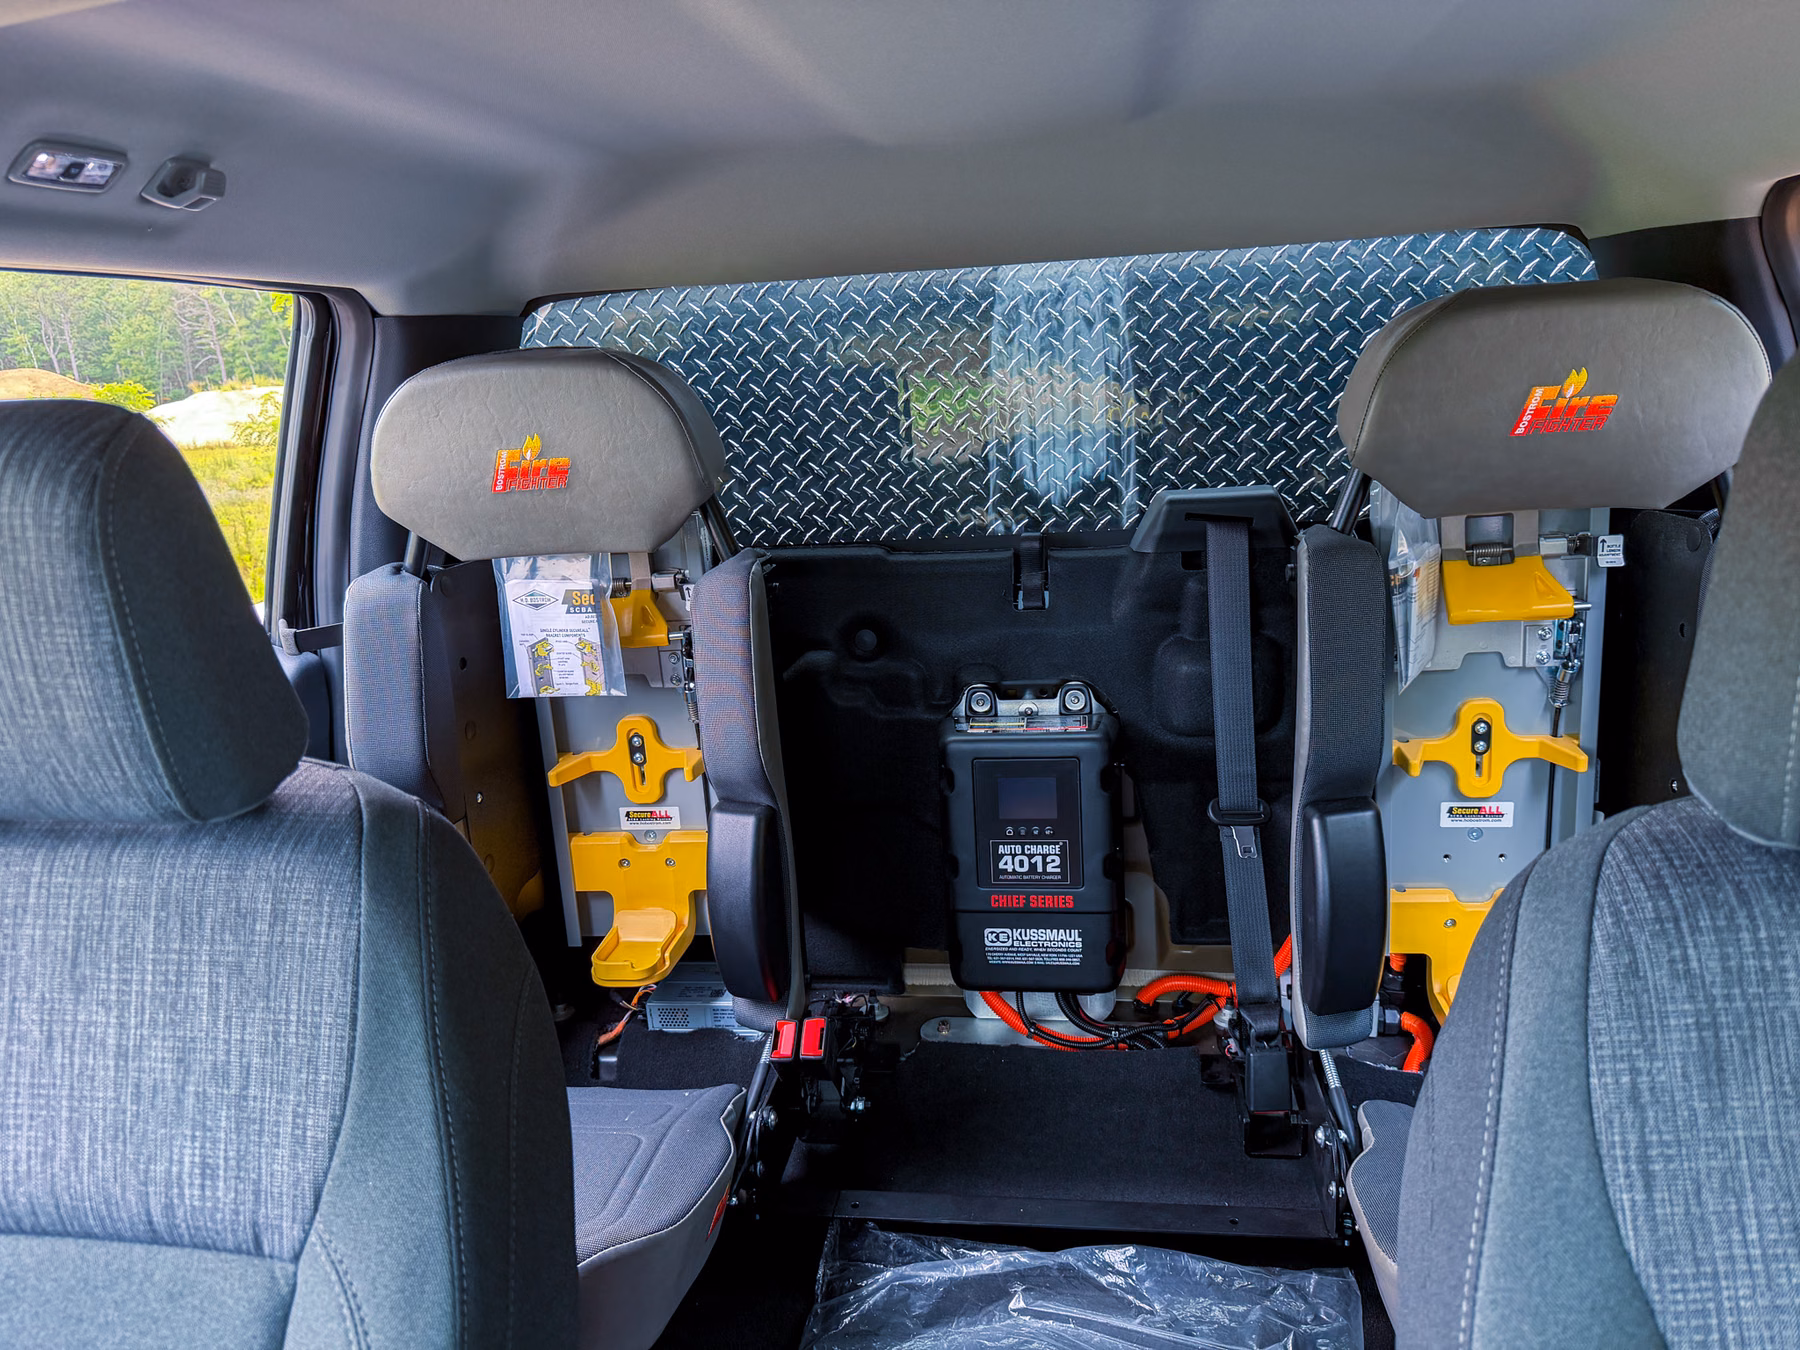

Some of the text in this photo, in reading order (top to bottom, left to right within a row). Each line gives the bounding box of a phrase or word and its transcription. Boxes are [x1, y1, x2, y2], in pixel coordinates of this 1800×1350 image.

[1514, 387, 1545, 435] BOSTROM
[1529, 416, 1608, 434] FIGHTER
[495, 451, 509, 491] BOSTROM
[506, 477, 569, 492] FIGHTER
[998, 844, 1061, 854] AUTO CHARGE
[998, 855, 1061, 873] 4012
[991, 895, 1075, 908] CHIEF SERIES
[1013, 928, 1082, 941] KUSSMAUL
